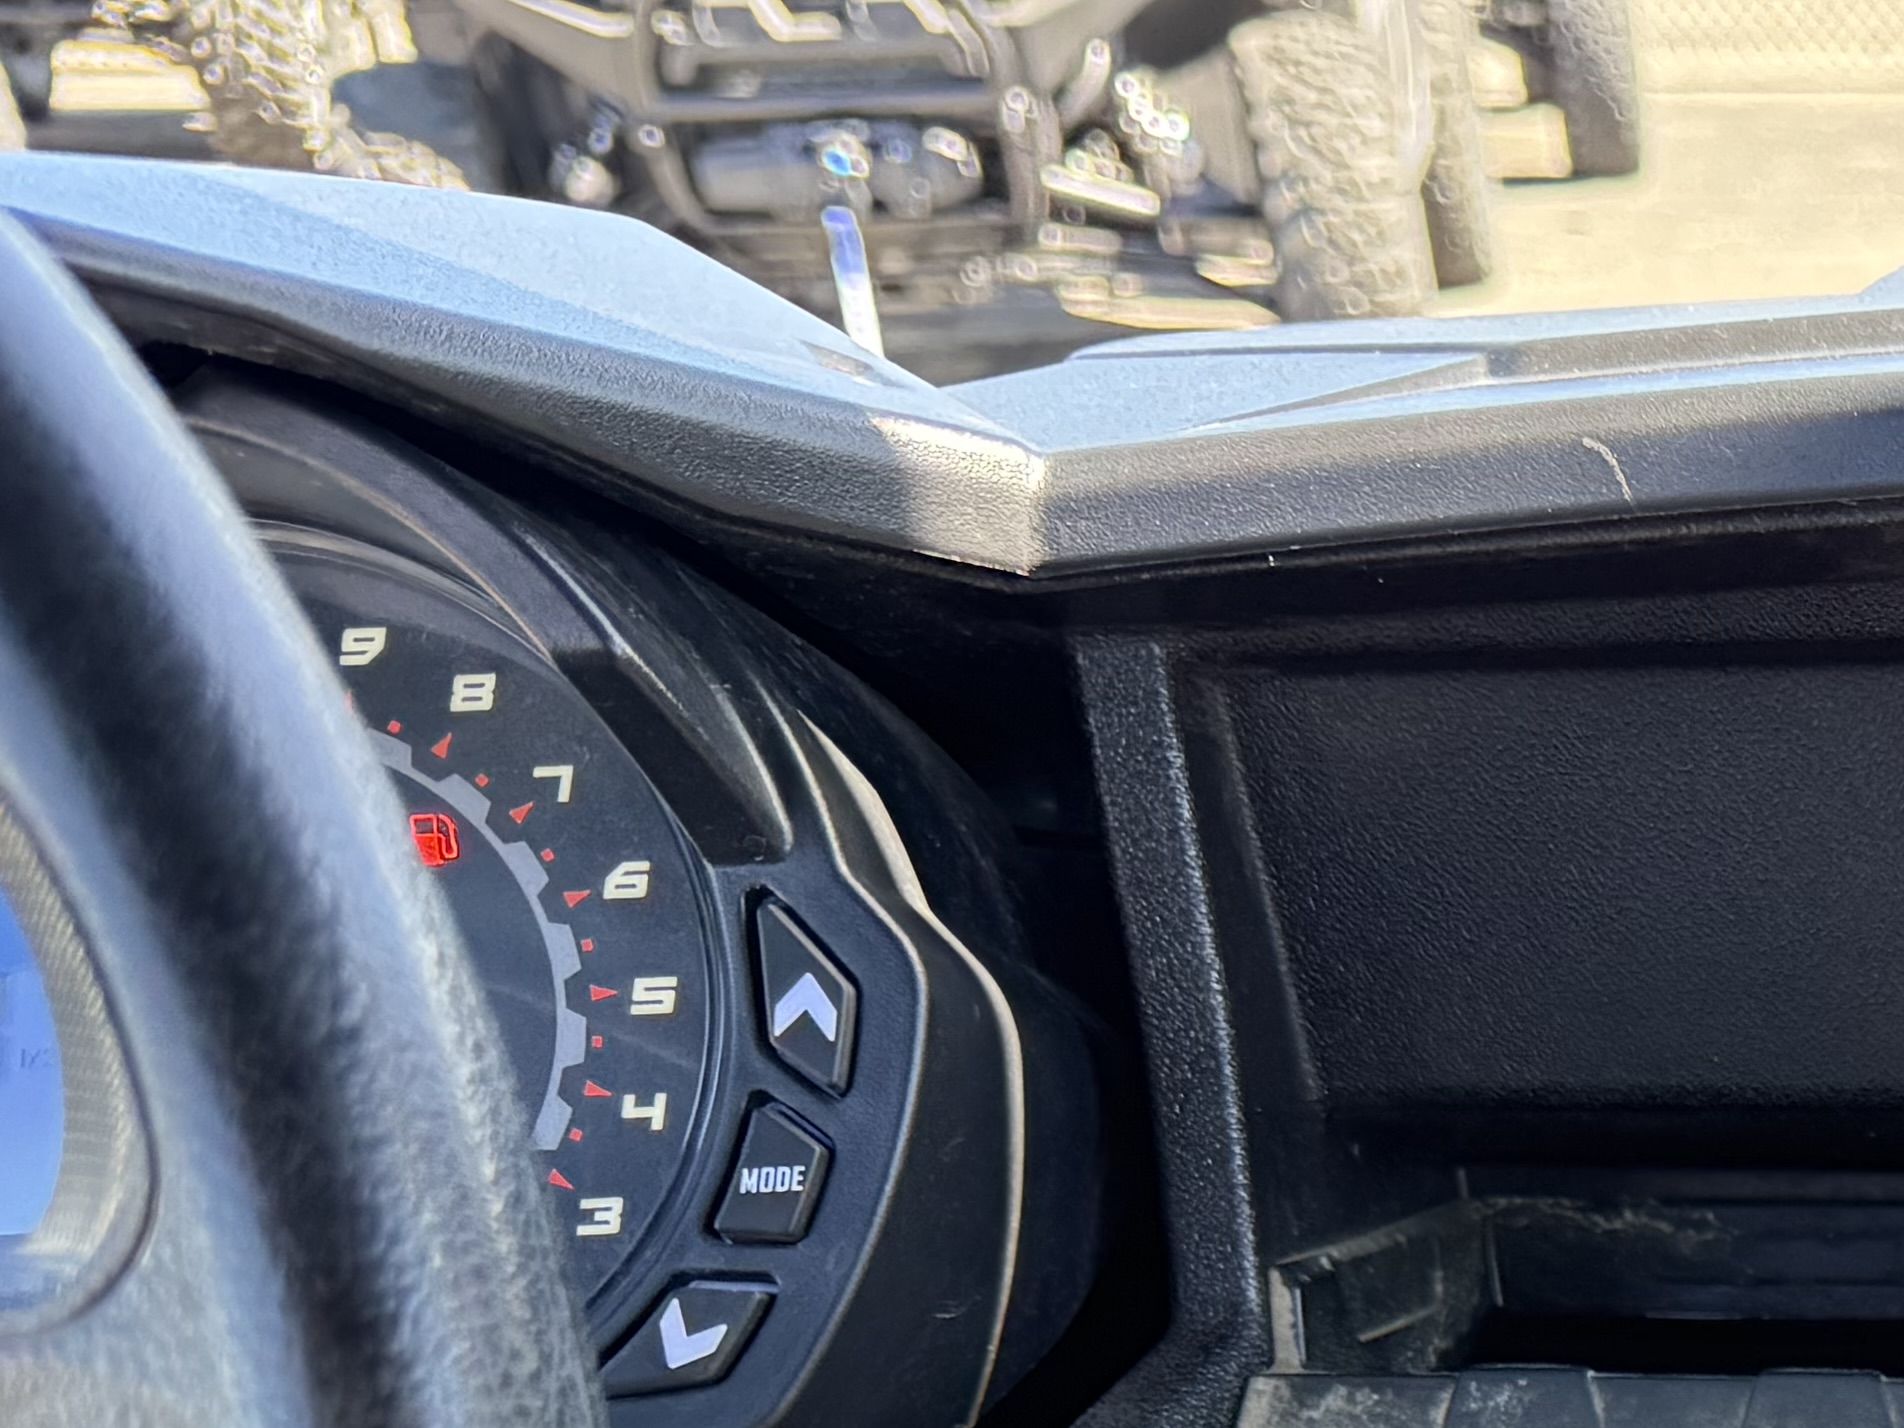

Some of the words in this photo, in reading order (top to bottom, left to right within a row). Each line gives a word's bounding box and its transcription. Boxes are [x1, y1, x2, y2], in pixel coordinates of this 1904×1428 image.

[339, 627, 387, 665] 9
[449, 673, 497, 712] 8
[532, 765, 573, 801] 7
[602, 861, 651, 899] 6
[629, 977, 678, 1015] 5
[621, 1092, 667, 1130] 4
[740, 1165, 805, 1195] MODE
[575, 1196, 623, 1235] 3
